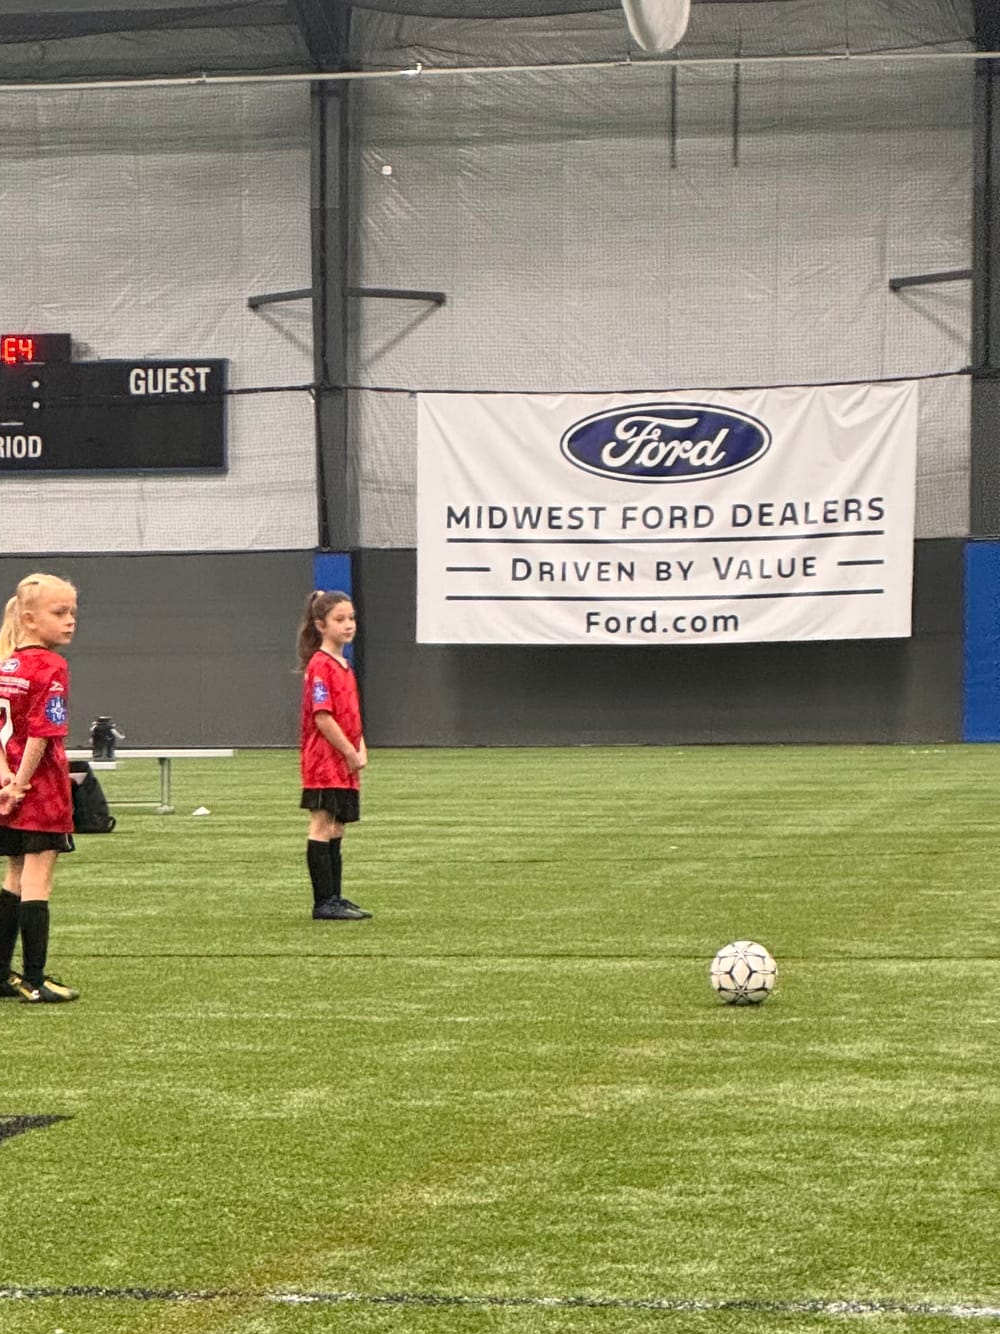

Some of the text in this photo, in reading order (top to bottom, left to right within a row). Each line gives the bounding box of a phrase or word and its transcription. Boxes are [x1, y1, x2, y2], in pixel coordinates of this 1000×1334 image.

[129, 367, 211, 395] GUEST
[602, 415, 730, 469] Ford
[446, 497, 885, 530] MIDWEST FORD DEALERS
[511, 556, 817, 582] DRIVEN BY VALUE
[585, 611, 739, 633] Ford.com
